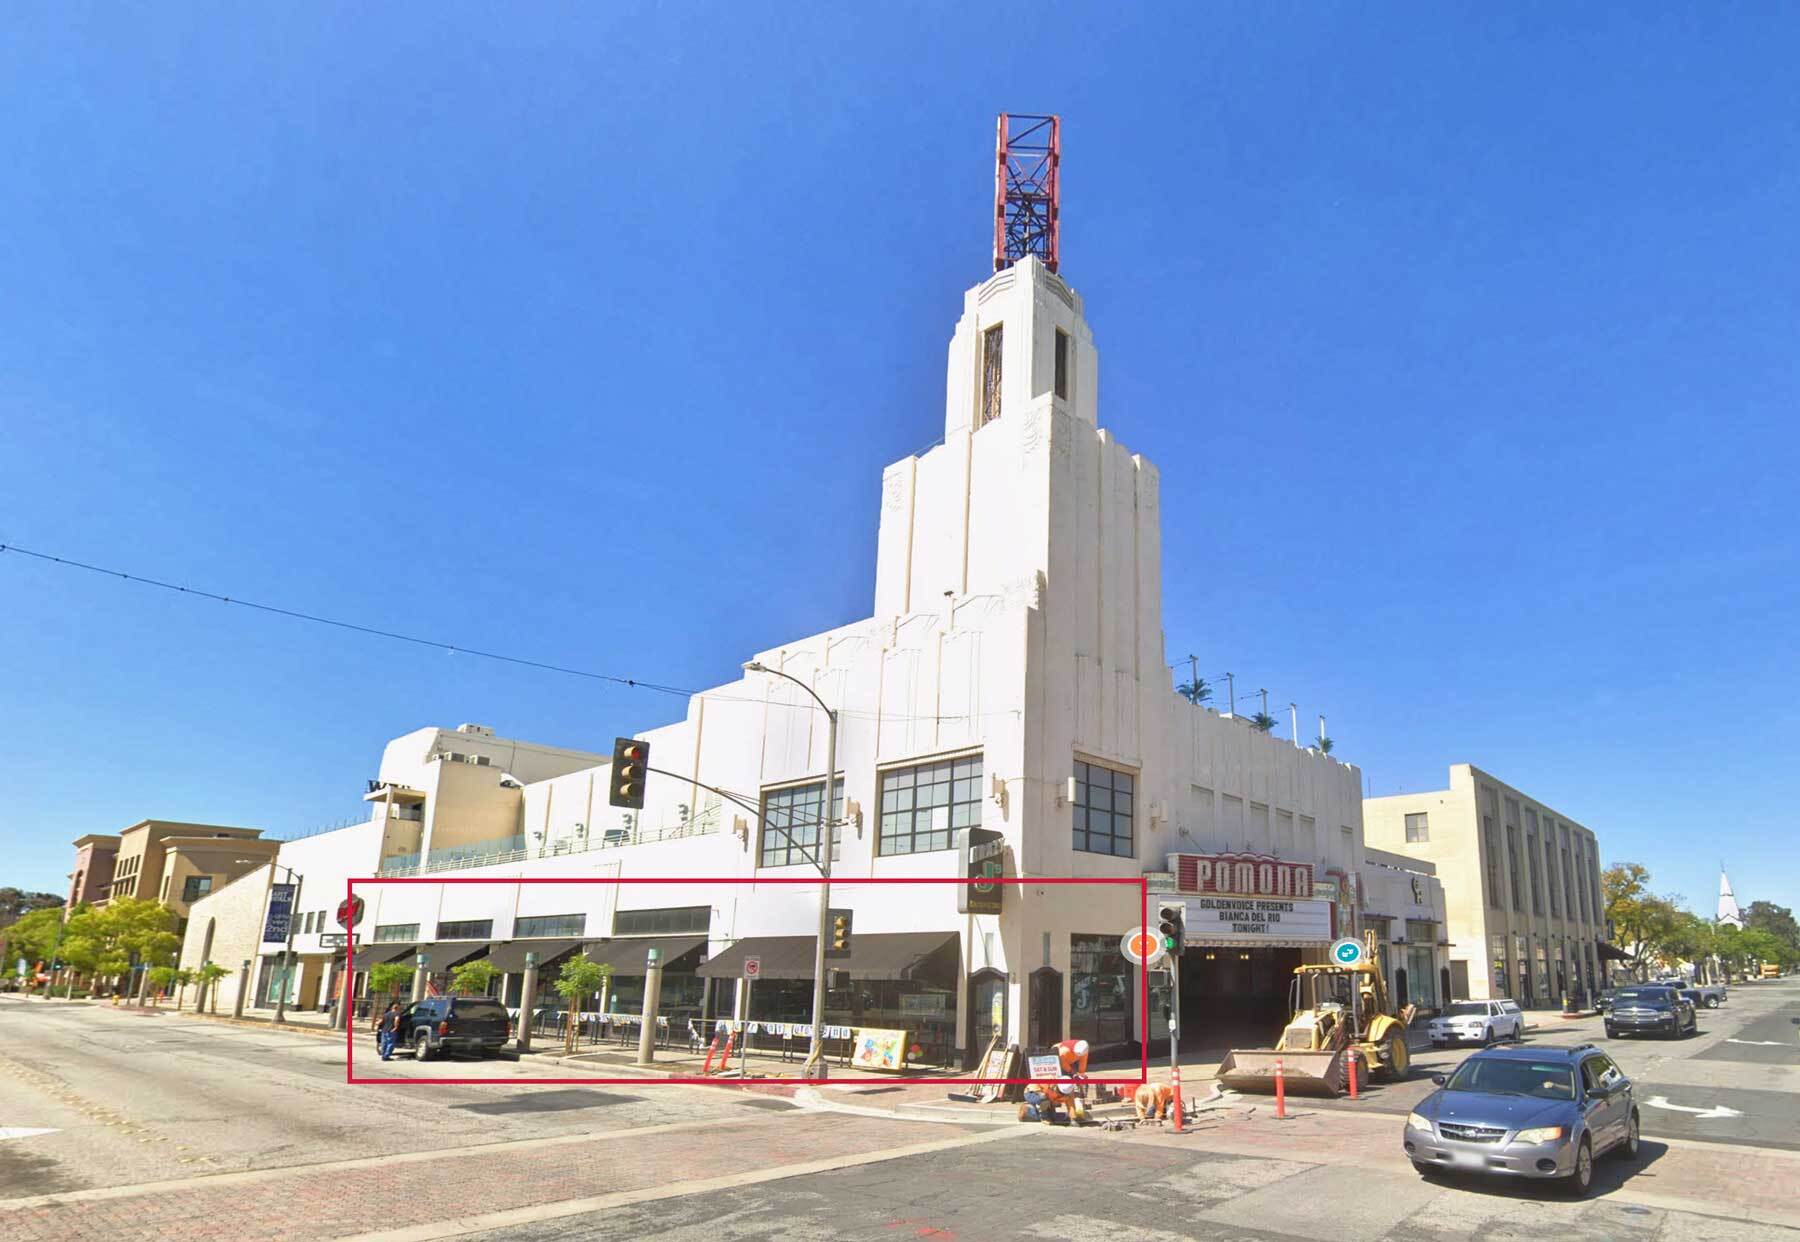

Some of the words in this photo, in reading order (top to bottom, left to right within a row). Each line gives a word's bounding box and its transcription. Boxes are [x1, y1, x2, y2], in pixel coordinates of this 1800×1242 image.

[1197, 860, 1309, 897] POMONA
[1200, 899, 1254, 911] GOLDENVOICE
[1256, 902, 1294, 913] PRESENTS
[1219, 911, 1250, 922] BIANCA
[1251, 912, 1266, 922] DEL
[1267, 913, 1281, 923] RIO
[1232, 923, 1270, 934] TONIGHT!
